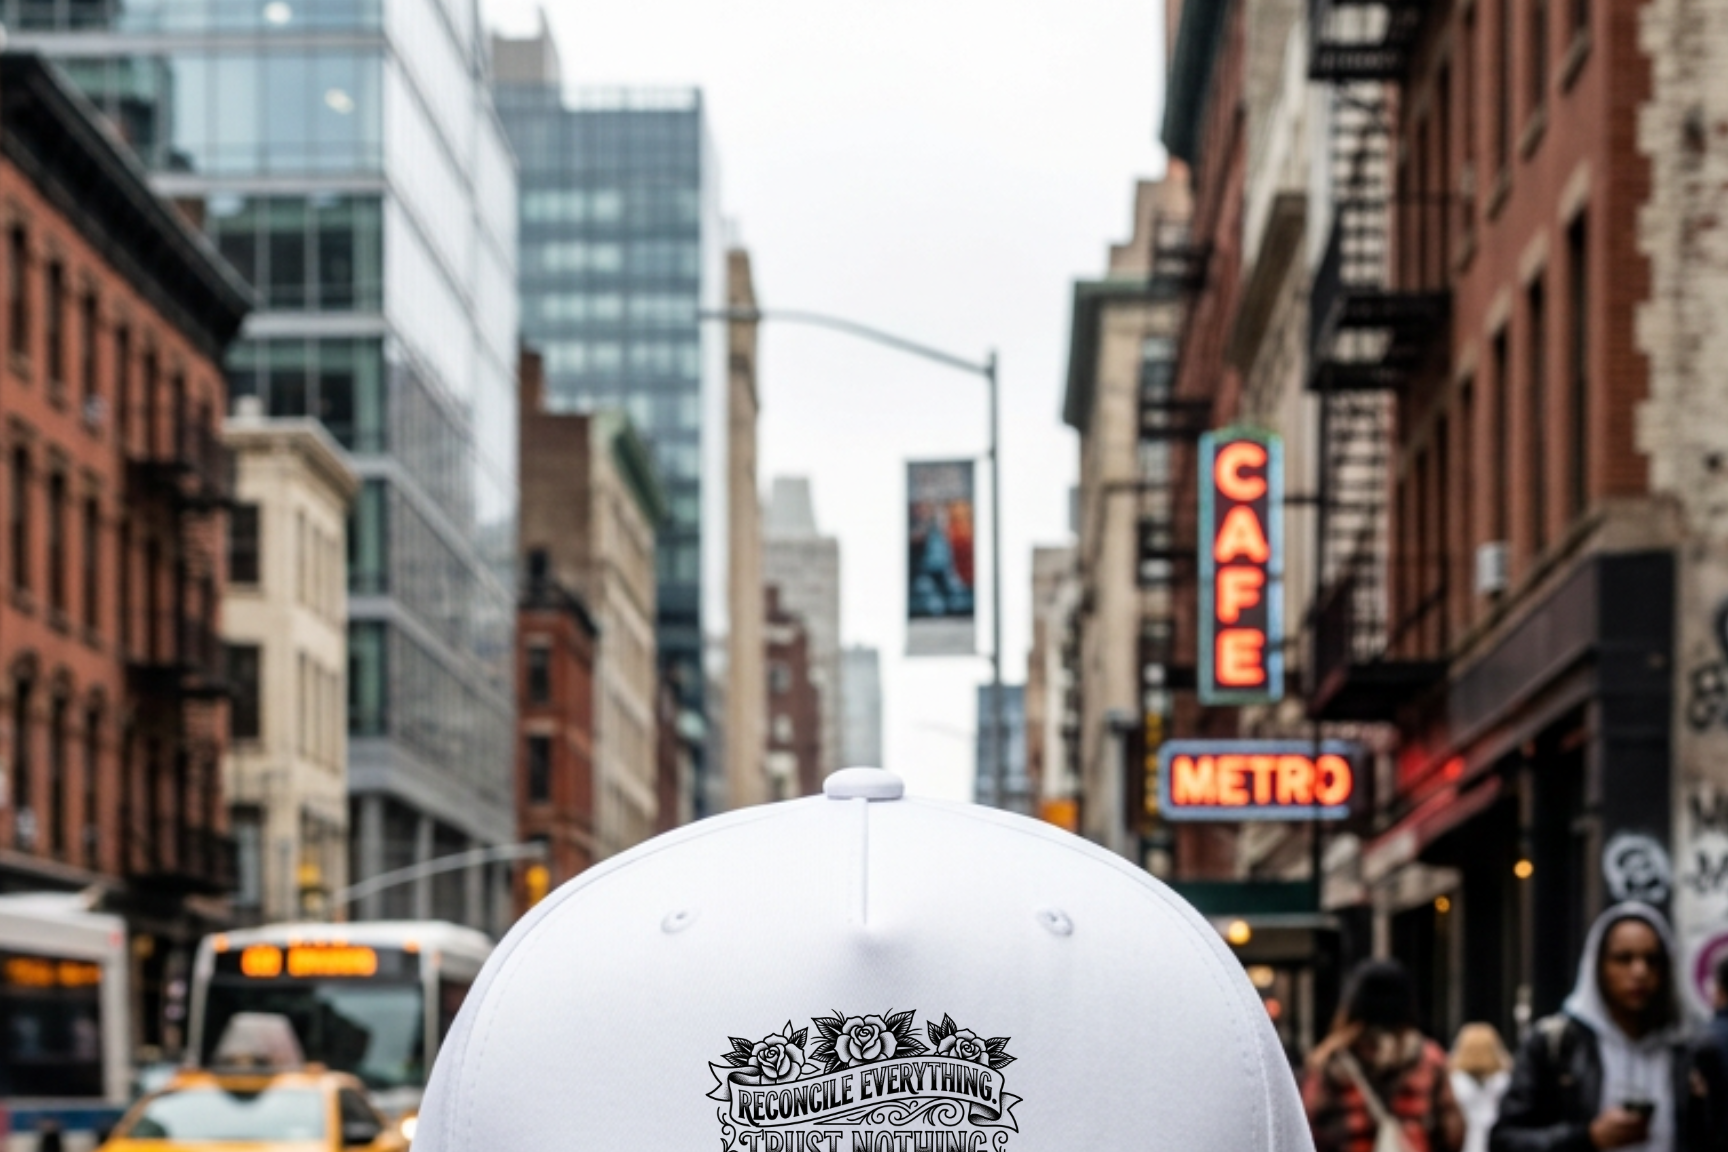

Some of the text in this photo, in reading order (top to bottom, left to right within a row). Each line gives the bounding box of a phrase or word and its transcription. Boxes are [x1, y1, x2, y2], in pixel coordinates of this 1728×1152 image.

[1214, 441, 1269, 686] CAFE
[1172, 754, 1353, 806] METRO
[738, 1062, 998, 1126] RECONCILE EVERYTHING.
